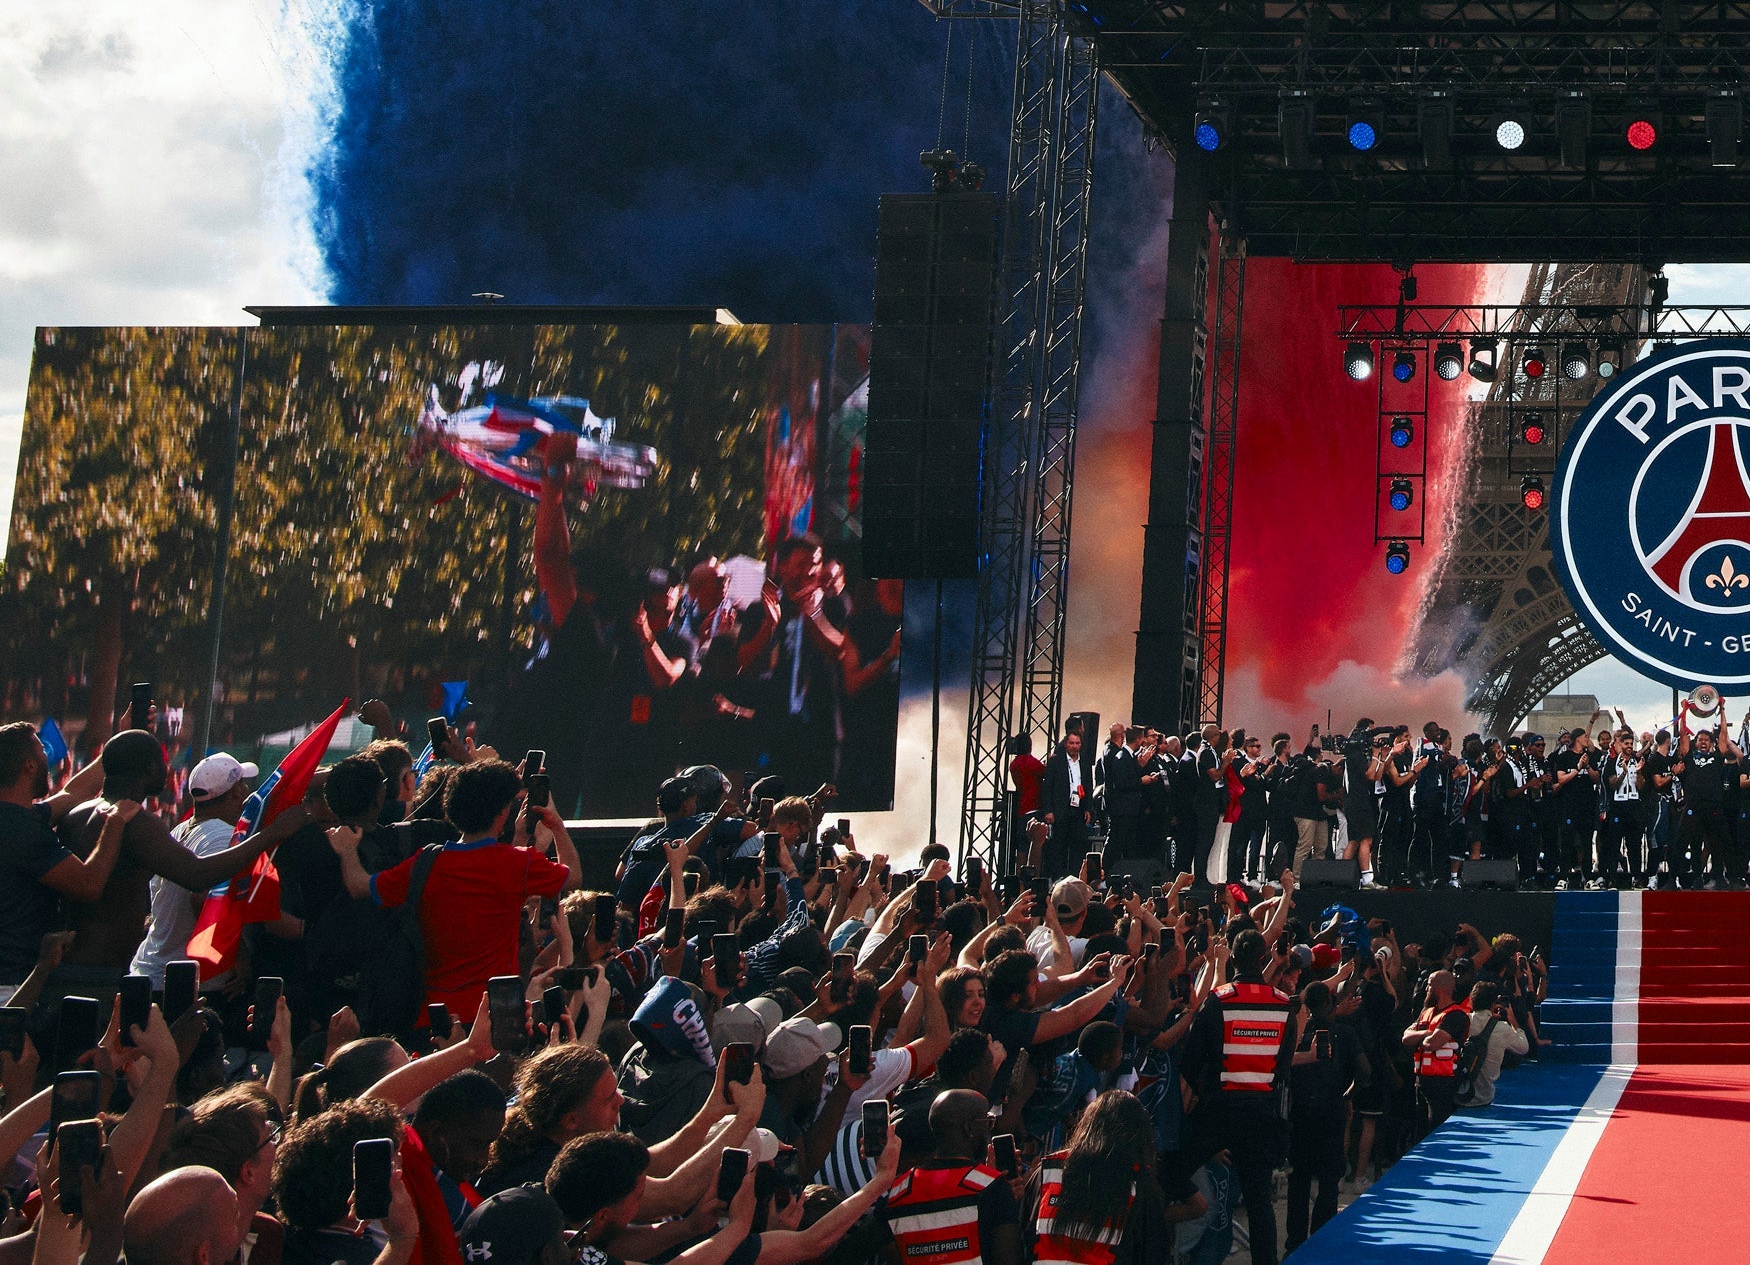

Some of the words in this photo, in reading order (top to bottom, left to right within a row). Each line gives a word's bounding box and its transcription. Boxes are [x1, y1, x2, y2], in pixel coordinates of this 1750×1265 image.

[1234, 1028, 1259, 1036] SÉCURITÉ
[1260, 1029, 1278, 1037] PRIVÉE
[907, 1242, 941, 1255] SÉCURITÉ
[941, 1239, 968, 1251] PRIVÉE
